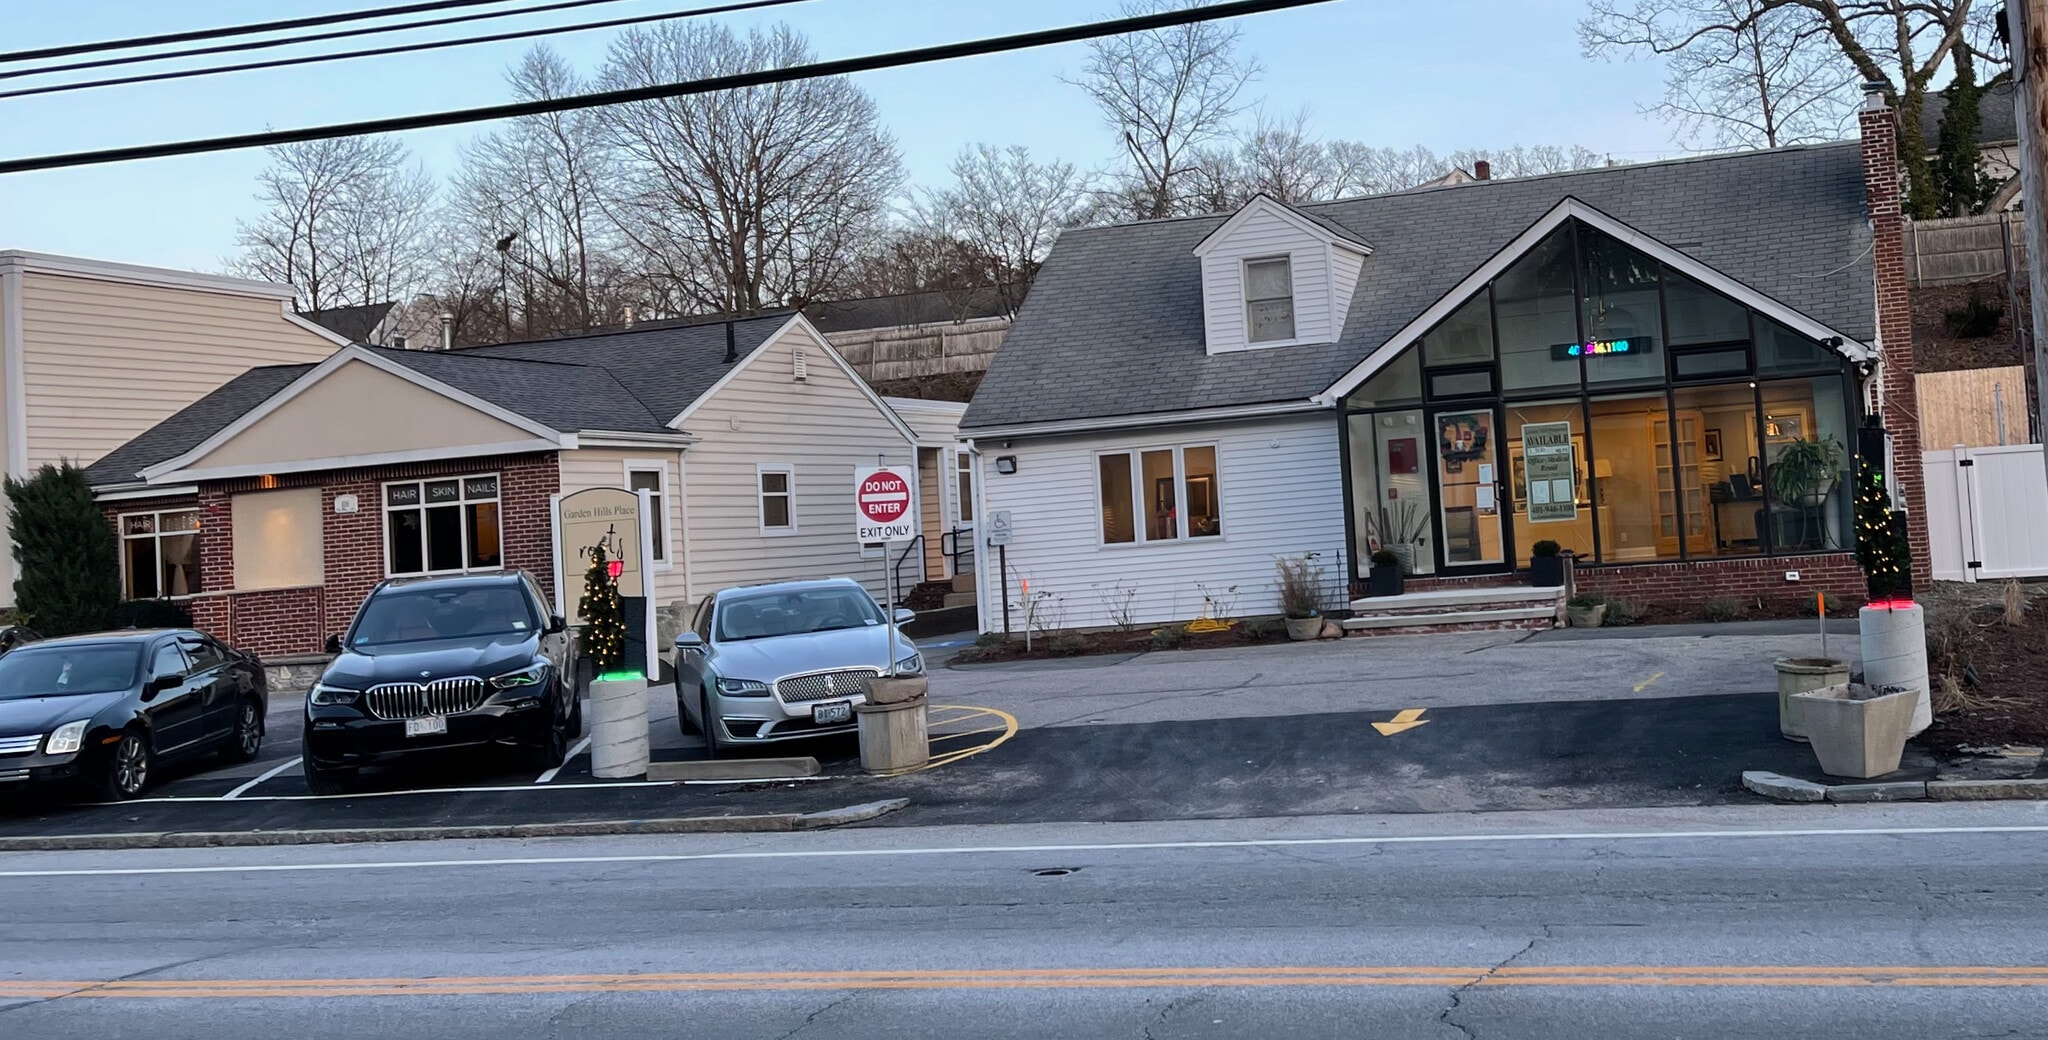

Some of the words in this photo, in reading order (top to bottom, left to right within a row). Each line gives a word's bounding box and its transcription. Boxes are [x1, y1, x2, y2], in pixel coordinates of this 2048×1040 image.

[1527, 434, 1569, 446] AVAILABLE
[393, 489, 417, 500] HAIR
[432, 486, 456, 497] SKIN
[467, 482, 497, 494] NAILS
[866, 481, 880, 492] DO
[882, 480, 901, 491] NOT
[564, 508, 592, 519] Garden
[594, 506, 613, 517] Hills
[614, 505, 635, 515] Place
[869, 503, 901, 514] ENTER
[130, 519, 153, 531] HAIR
[861, 527, 883, 538] EXIT
[885, 525, 909, 536] ONLY
